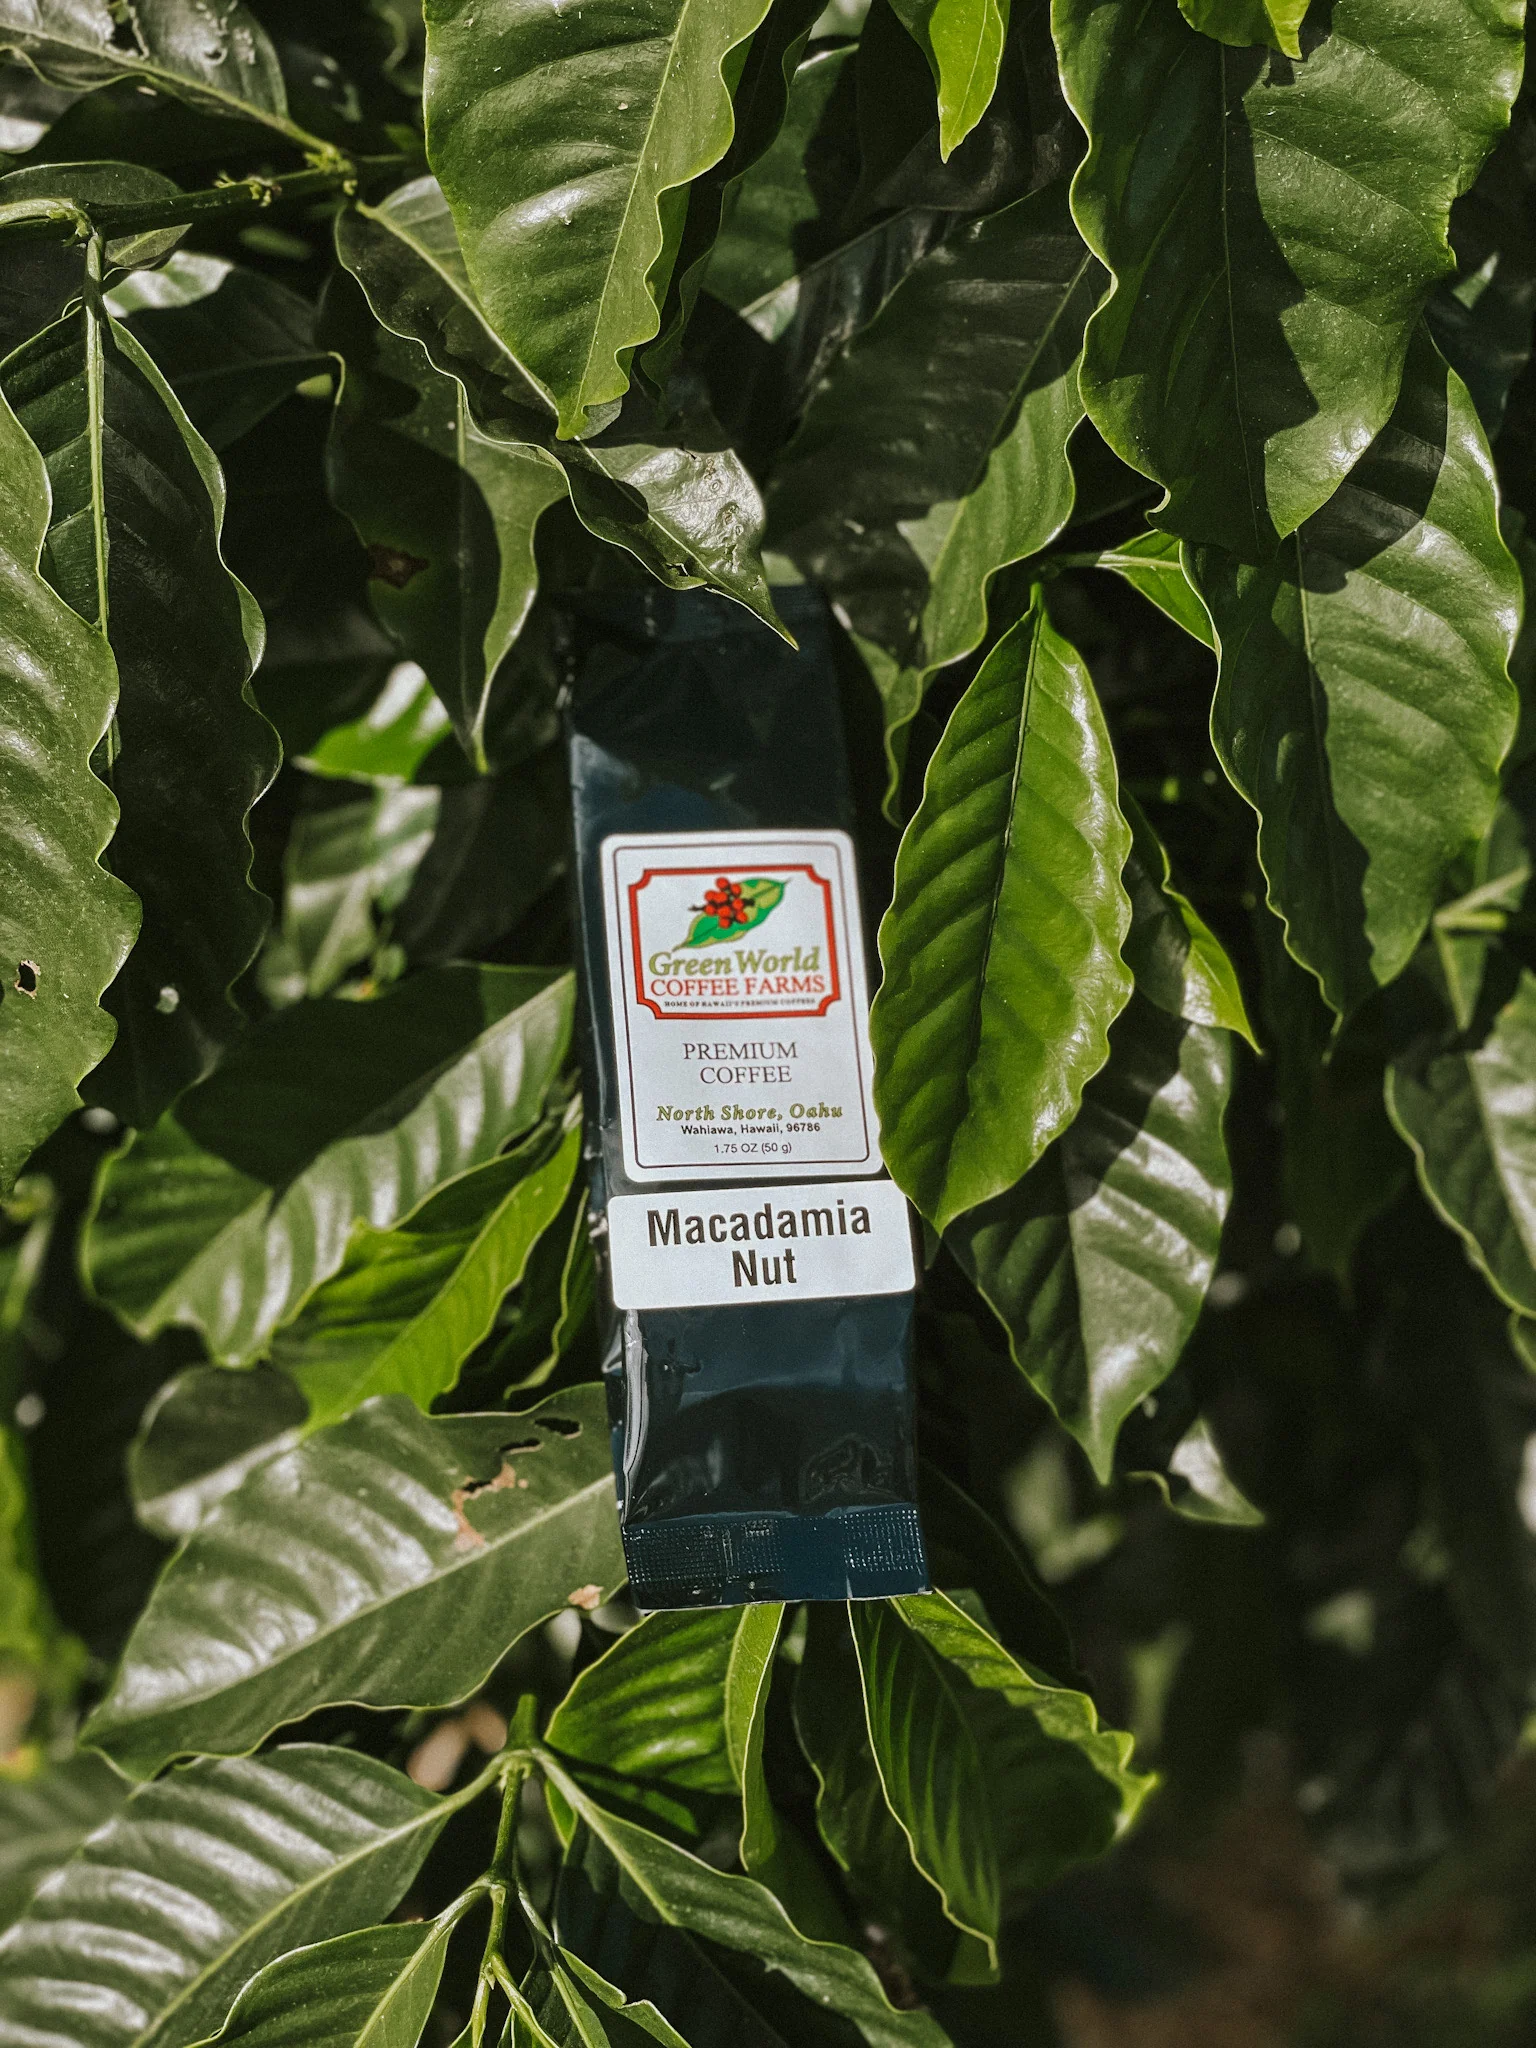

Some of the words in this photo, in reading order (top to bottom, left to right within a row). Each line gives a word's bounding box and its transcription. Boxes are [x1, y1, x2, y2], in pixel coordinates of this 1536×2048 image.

[648, 951, 732, 977] Green
[734, 946, 821, 975] World
[650, 977, 740, 997] COFFEE
[744, 974, 826, 996] FARMS
[664, 1000, 688, 1008] HOME
[689, 1000, 700, 1008] OF
[683, 1041, 799, 1061] PREMIUM
[700, 1065, 792, 1085] COFFEE
[656, 1104, 715, 1122] North
[720, 1103, 784, 1122] Shore,
[789, 1101, 843, 1120] Oahu
[681, 1124, 737, 1136] Wahiawa,
[740, 1123, 784, 1135] Hawaii,
[786, 1122, 821, 1133] 96786
[714, 1143, 738, 1154] 1.75
[740, 1143, 759, 1153] OZ
[761, 1142, 778, 1154] (50
[781, 1141, 793, 1154] g)
[646, 1198, 872, 1247] Macadamia
[731, 1247, 798, 1288] Nut
